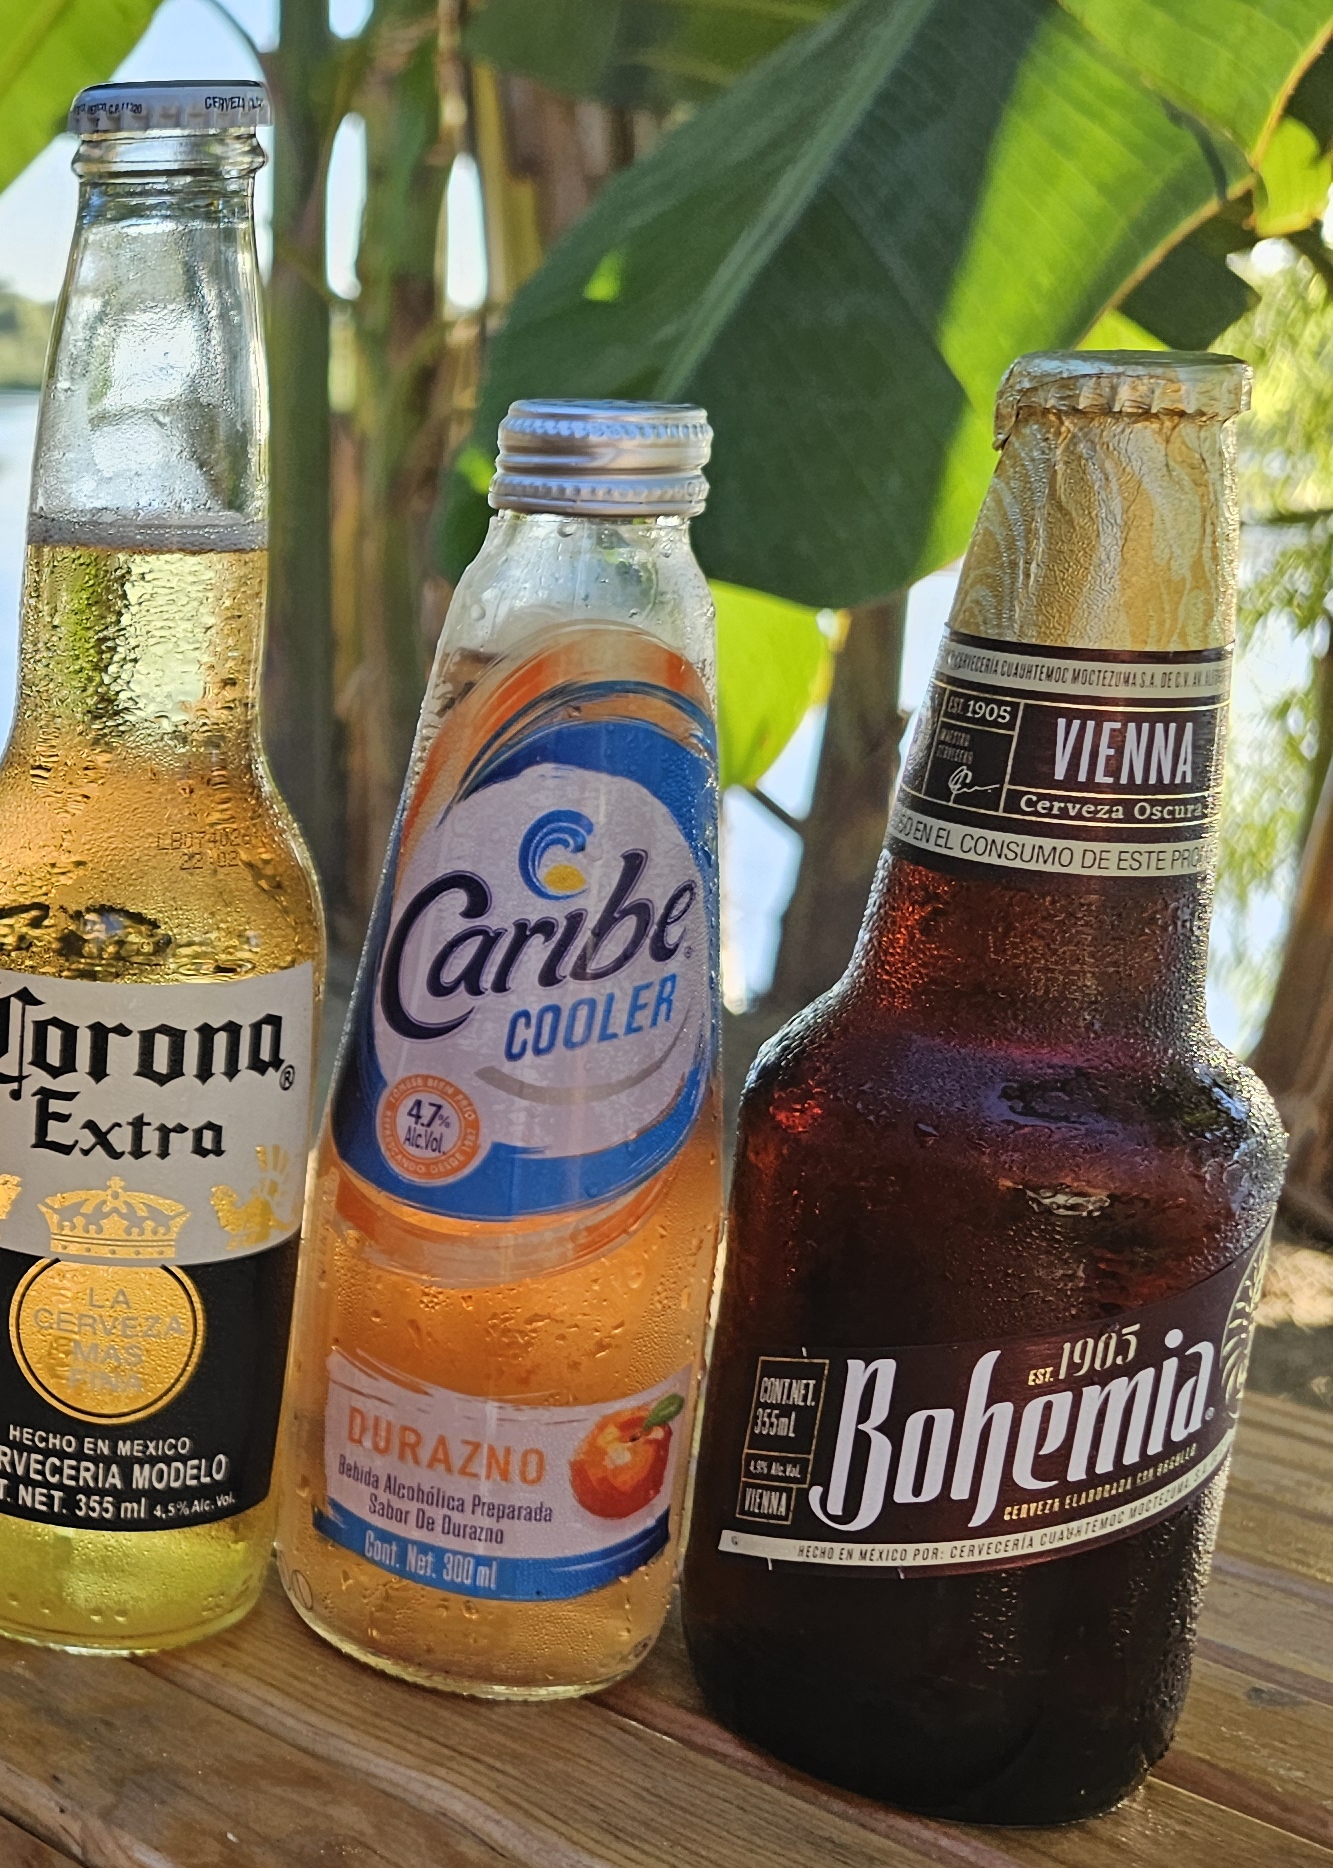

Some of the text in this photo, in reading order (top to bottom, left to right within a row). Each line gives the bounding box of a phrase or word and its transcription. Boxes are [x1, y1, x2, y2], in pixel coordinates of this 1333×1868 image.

[1071, 669, 1137, 688] MOCTEZUMA
[1139, 672, 1158, 689] S.A.
[1160, 671, 1173, 688] DE
[965, 700, 1012, 723] 1905
[1054, 717, 1194, 785] VIENNA
[1020, 794, 1203, 821] Cerveza Oscura
[913, 820, 933, 844] EN
[934, 827, 954, 850] EL
[960, 833, 1075, 868] CONSUMO
[1081, 849, 1111, 871] DE
[1116, 850, 1166, 871] ESTE
[379, 848, 698, 1040] Caribe
[504, 972, 678, 1063] COOLER
[30, 1086, 228, 1160] Extra
[87, 1285, 132, 1309] LA
[32, 1306, 184, 1340] CERVEZA
[71, 1340, 145, 1368] MAS
[1027, 1323, 1141, 1386] EST. 1905
[68, 1368, 144, 1394] FINA
[9, 1423, 191, 1457] HECHO EN MEXICO
[348, 1405, 546, 1485] DURAZNO
[808, 1328, 1215, 1531] Bohemia
[132, 1453, 228, 1490] MODELO
[338, 1454, 554, 1523] Bebida Alcohólica Preparada
[18, 1482, 68, 1515] NET.
[74, 1493, 114, 1520] 355
[120, 1495, 147, 1520] ml
[191, 1498, 215, 1513] Alc.
[744, 1487, 788, 1517] VIENNA
[1003, 1478, 1132, 1521] CERVEZA ELABORADA
[368, 1495, 505, 1545] Sabor De Durazno
[364, 1530, 498, 1591] Cont. Net. 300 ml
[796, 1534, 1034, 1562] HECHO EN MÉXICO POR: CERVECERÍA
